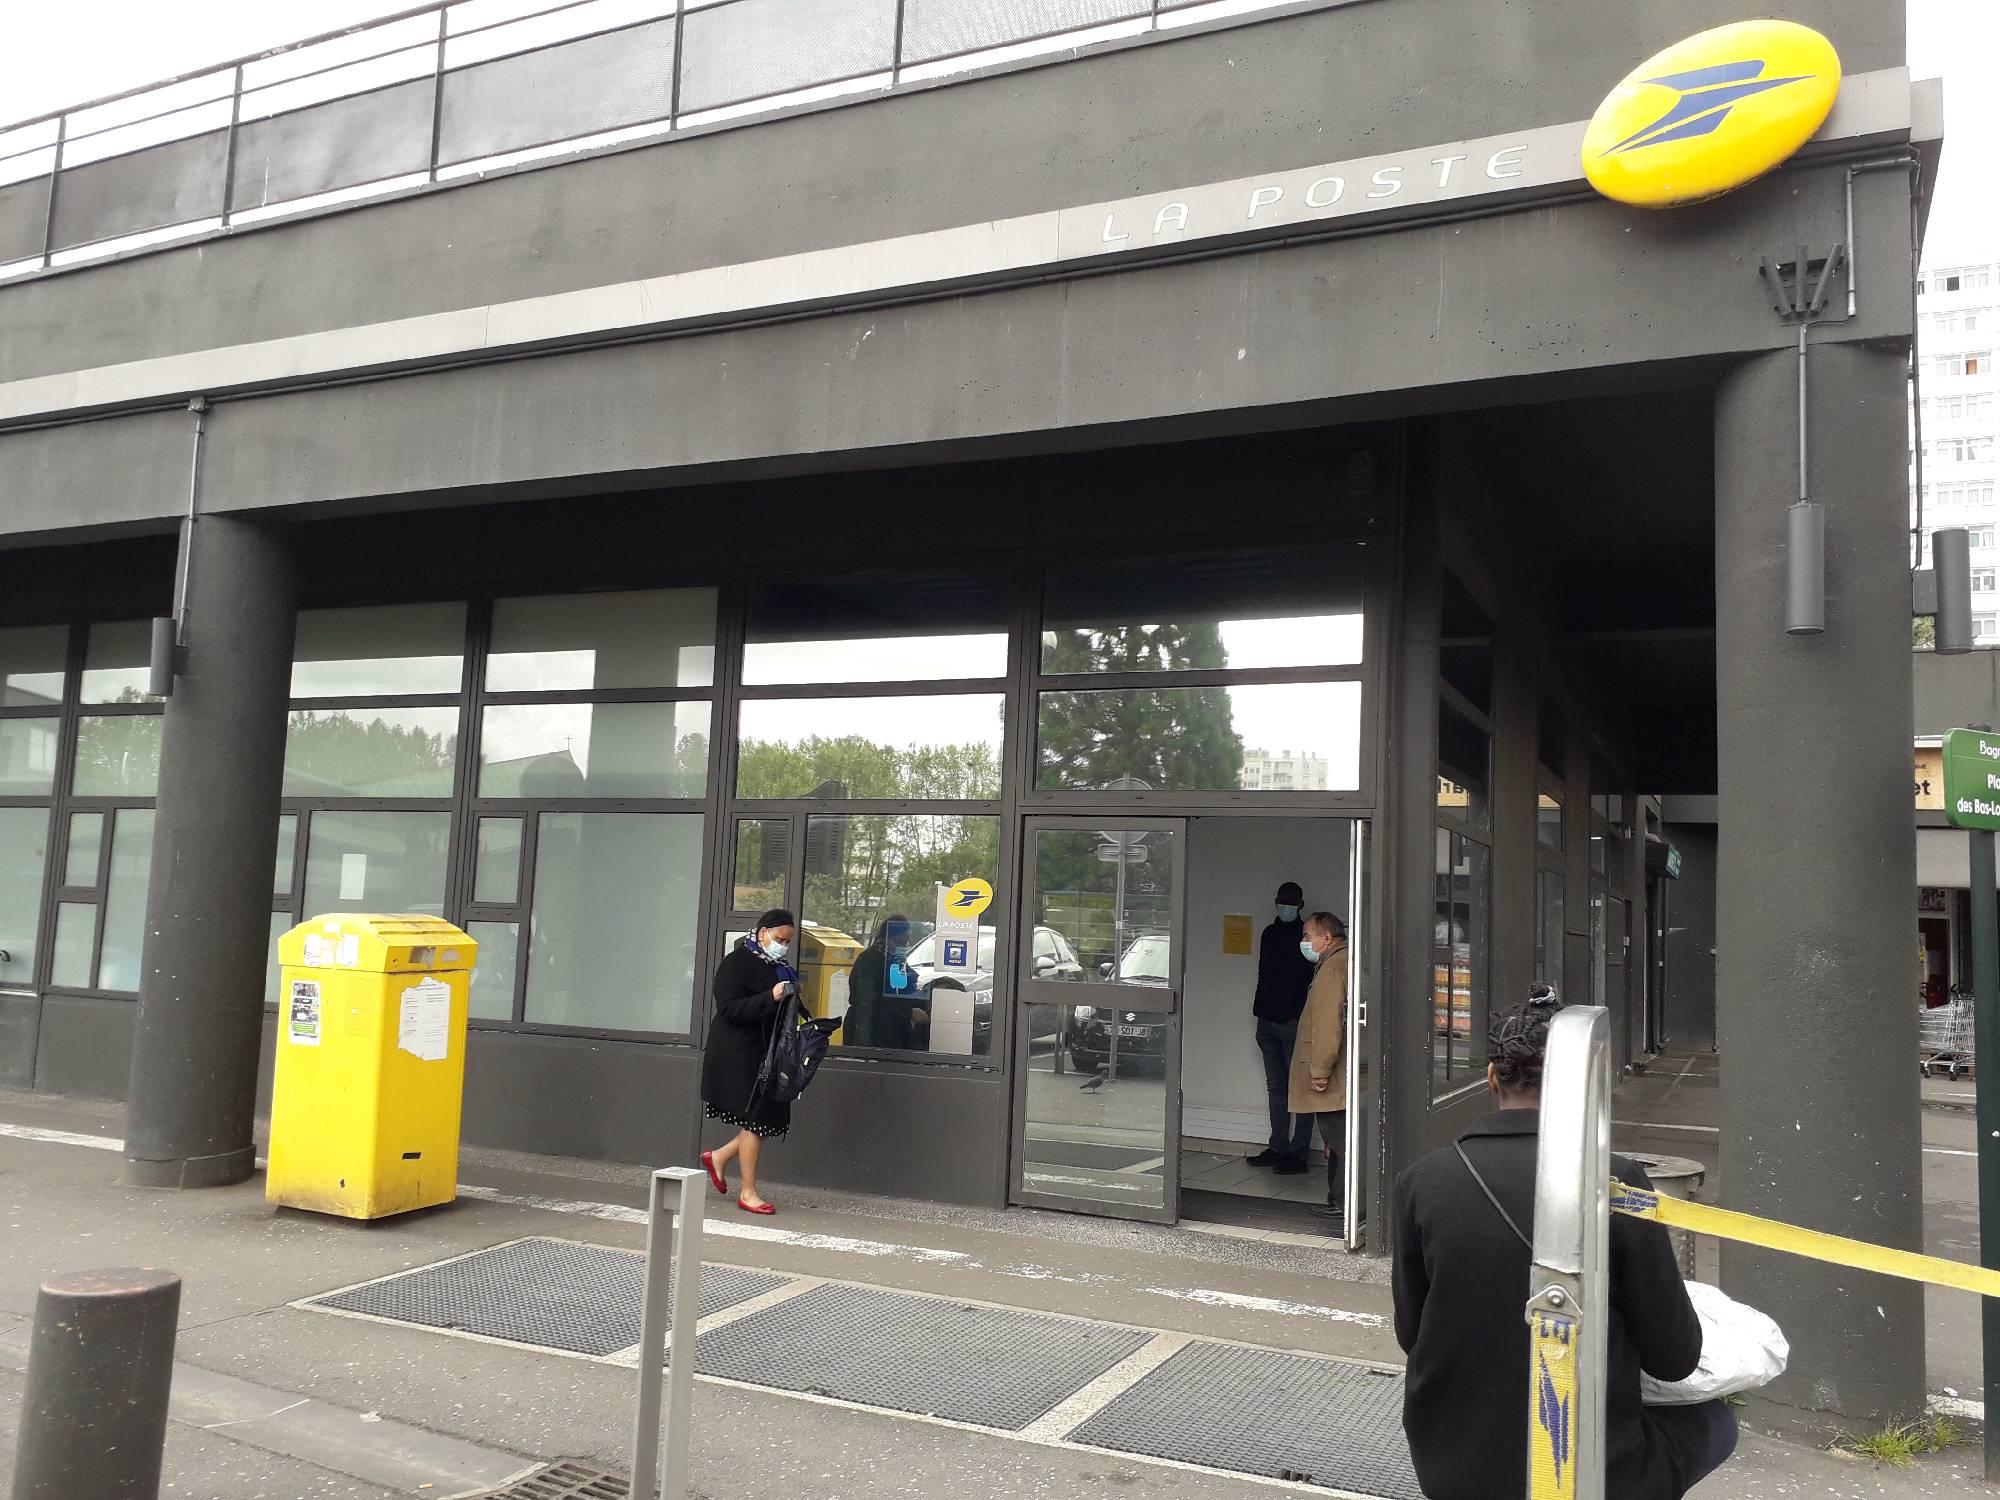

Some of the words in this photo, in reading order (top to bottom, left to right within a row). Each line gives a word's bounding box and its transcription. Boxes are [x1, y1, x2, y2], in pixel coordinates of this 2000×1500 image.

[1102, 202, 1190, 242] LA
[1247, 144, 1529, 219] POSTE
[1956, 797, 1973, 813] des
[949, 921, 975, 929] POSTE
